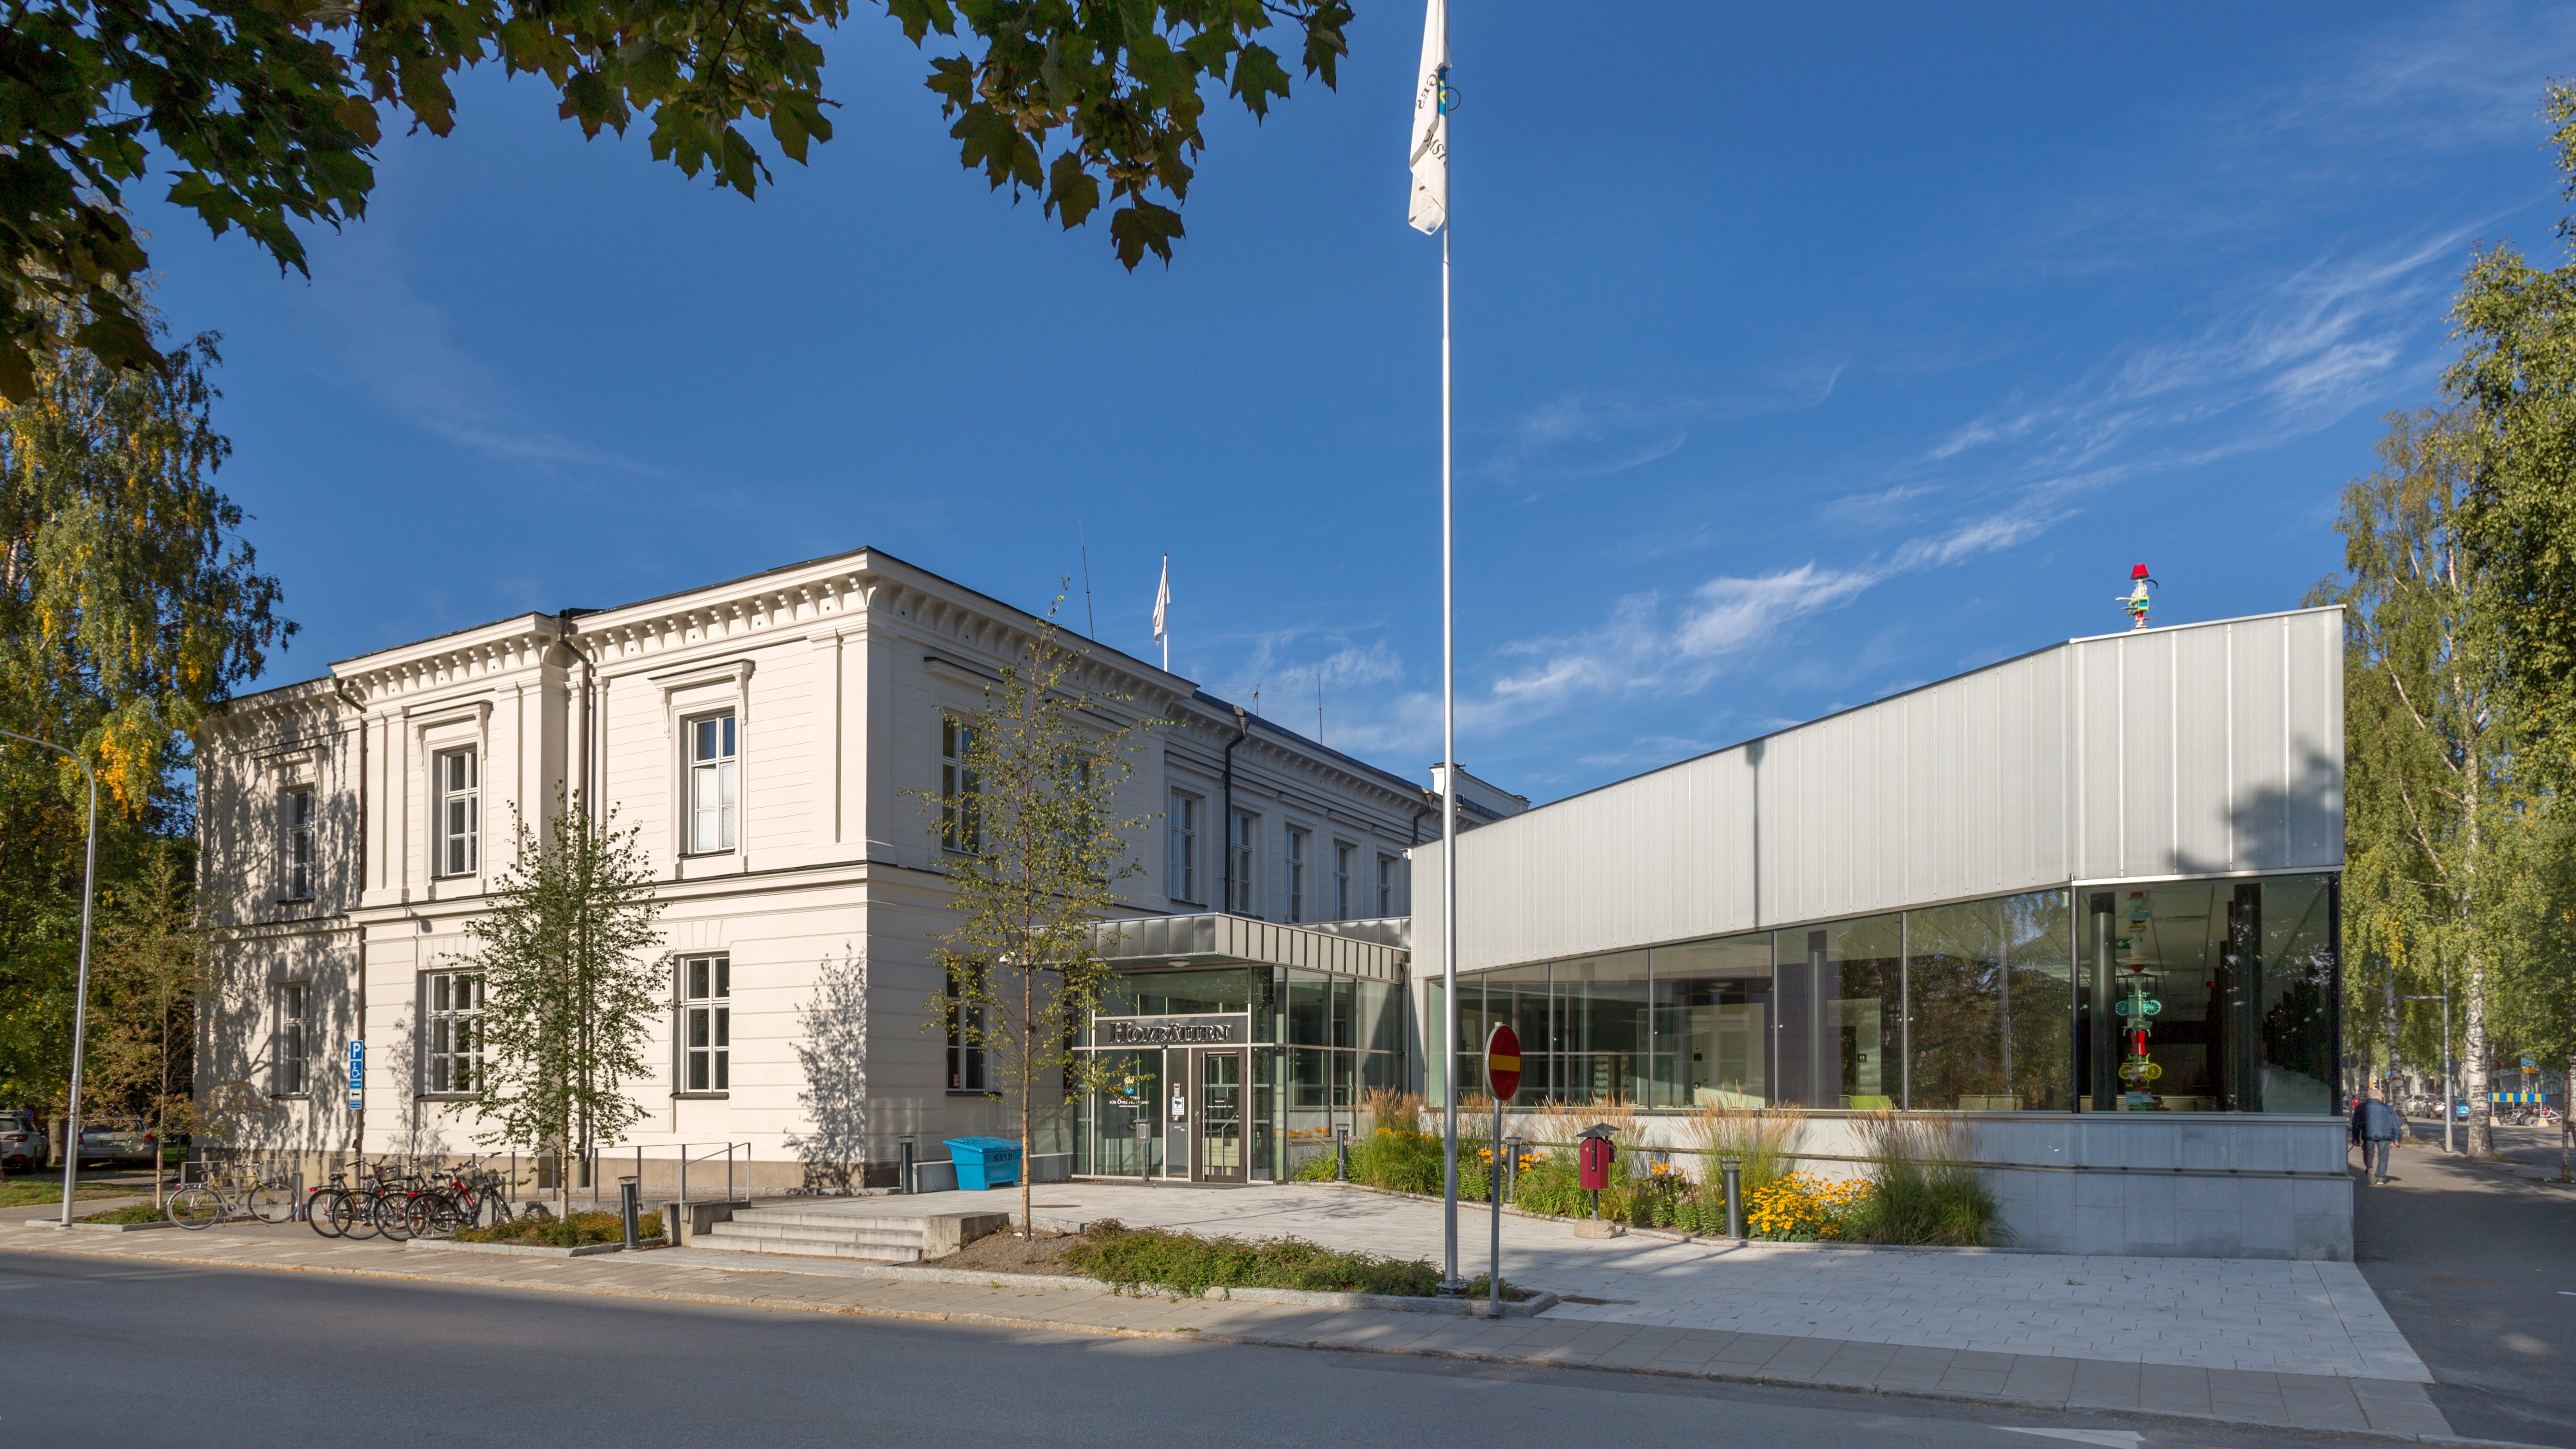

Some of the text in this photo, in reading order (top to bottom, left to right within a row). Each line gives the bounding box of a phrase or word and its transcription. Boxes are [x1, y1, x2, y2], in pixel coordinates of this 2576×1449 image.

[1109, 1022, 1233, 1043] HOVRÄTTEN
[353, 1042, 361, 1058] P
[994, 1153, 1013, 1162] SAND
